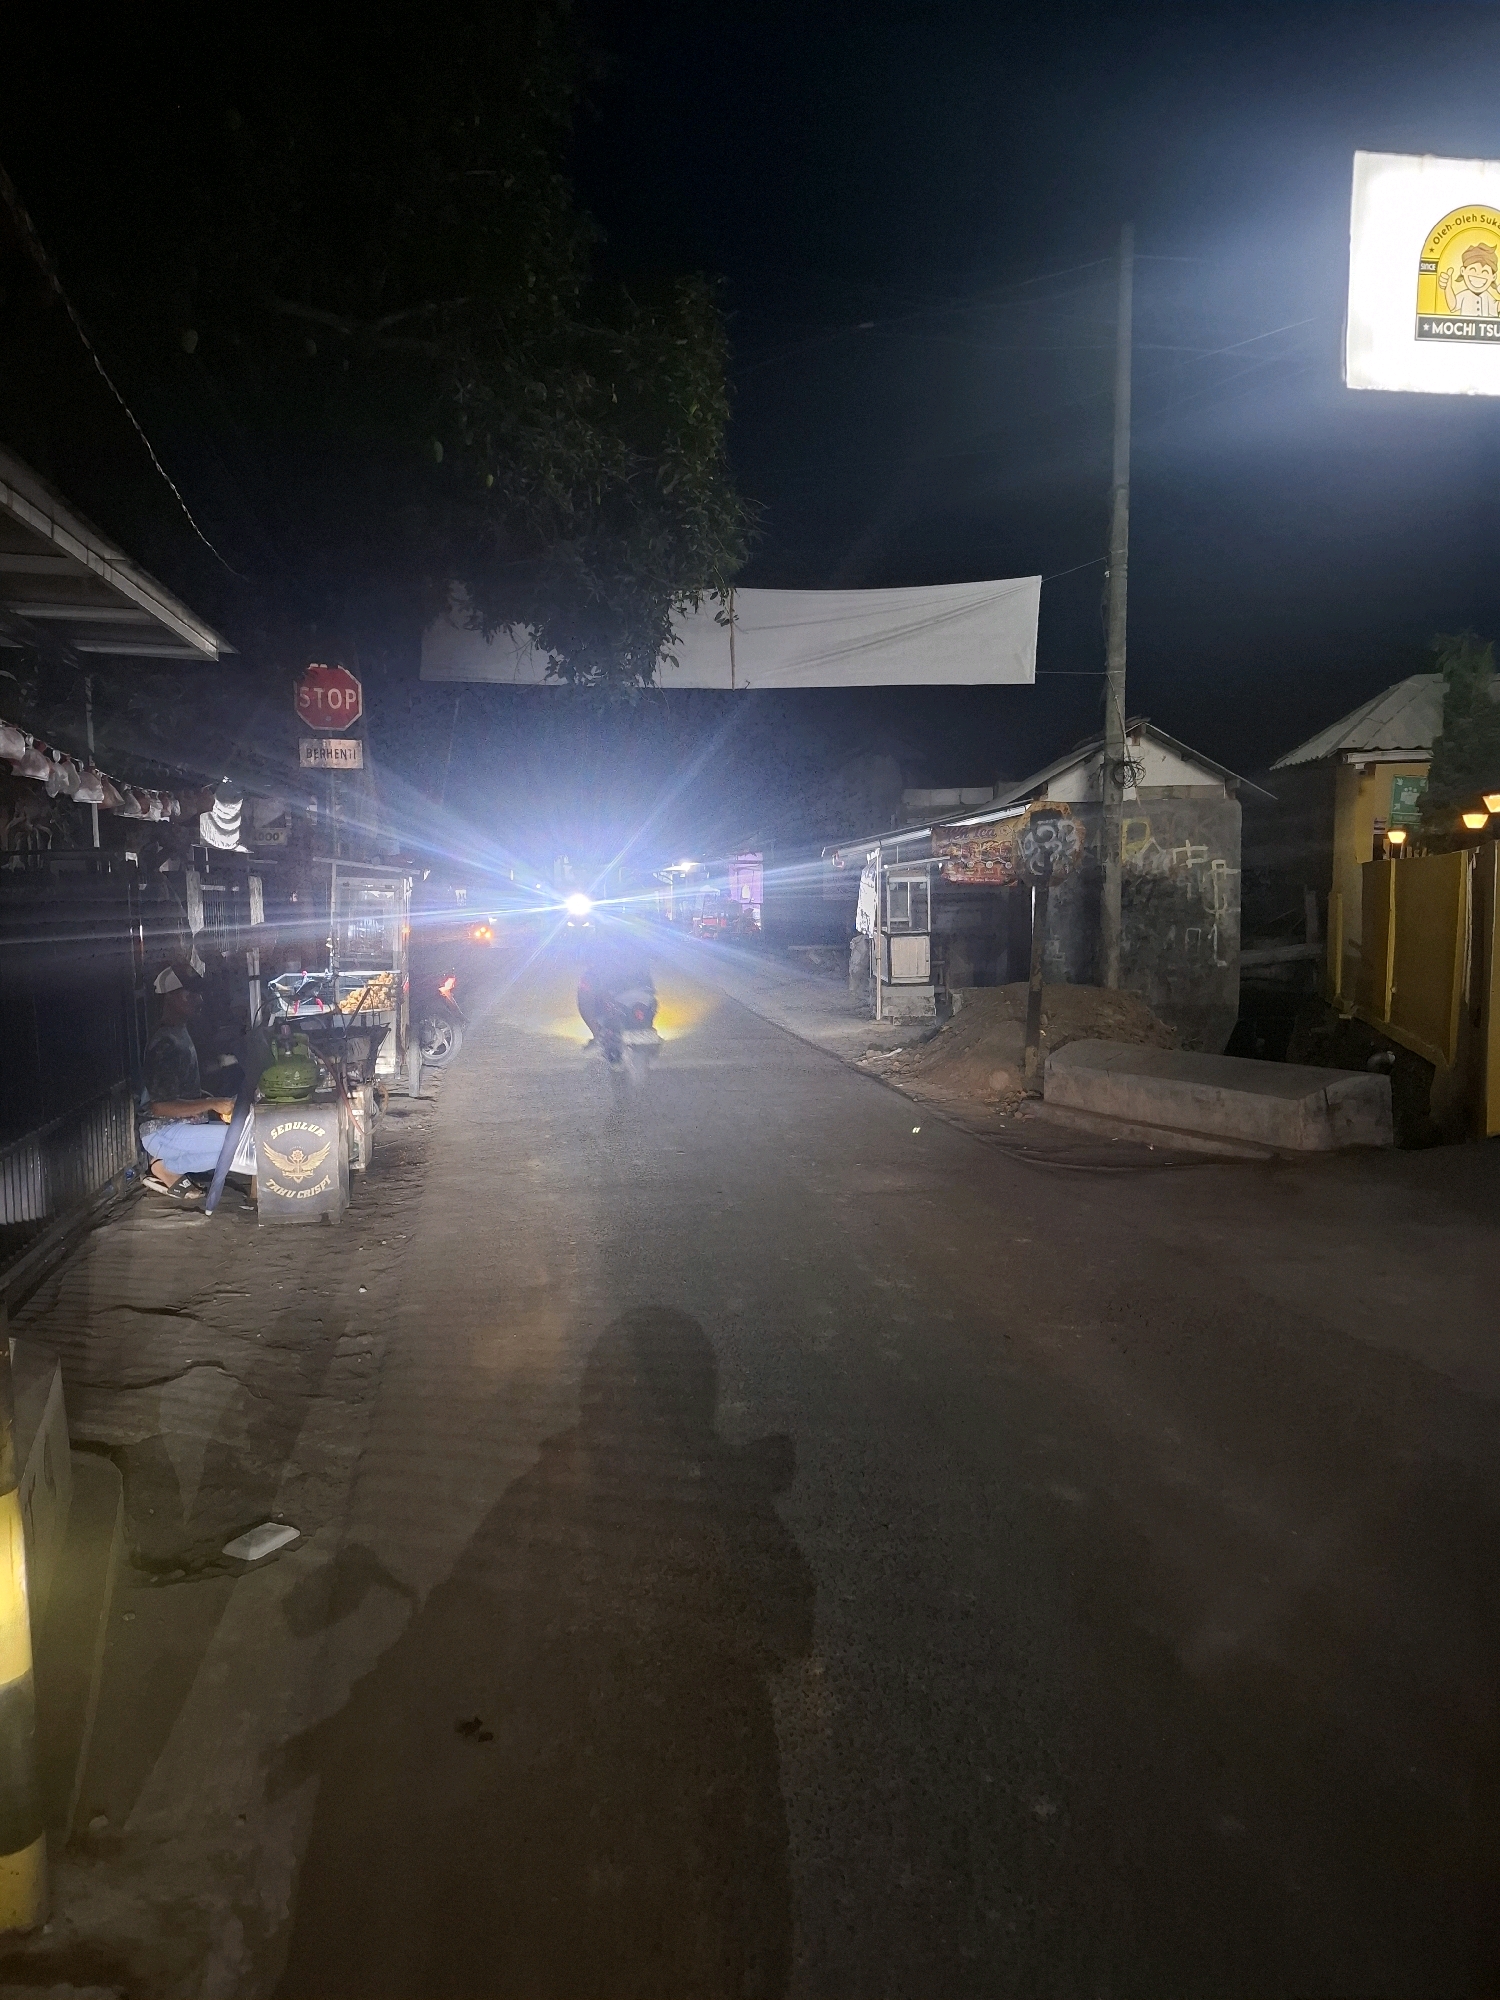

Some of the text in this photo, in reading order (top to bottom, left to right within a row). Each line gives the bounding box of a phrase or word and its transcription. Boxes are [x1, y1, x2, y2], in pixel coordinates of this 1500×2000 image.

[1432, 213, 1478, 245] Oleh-Oleh
[1420, 262, 1437, 271] SINCE
[1431, 321, 1476, 336] MOCHI
[299, 686, 357, 710] STOP
[306, 748, 357, 761] BERHENTI
[270, 1121, 326, 1140] SEDULUR
[266, 1174, 332, 1199] TAHU CRISPY
